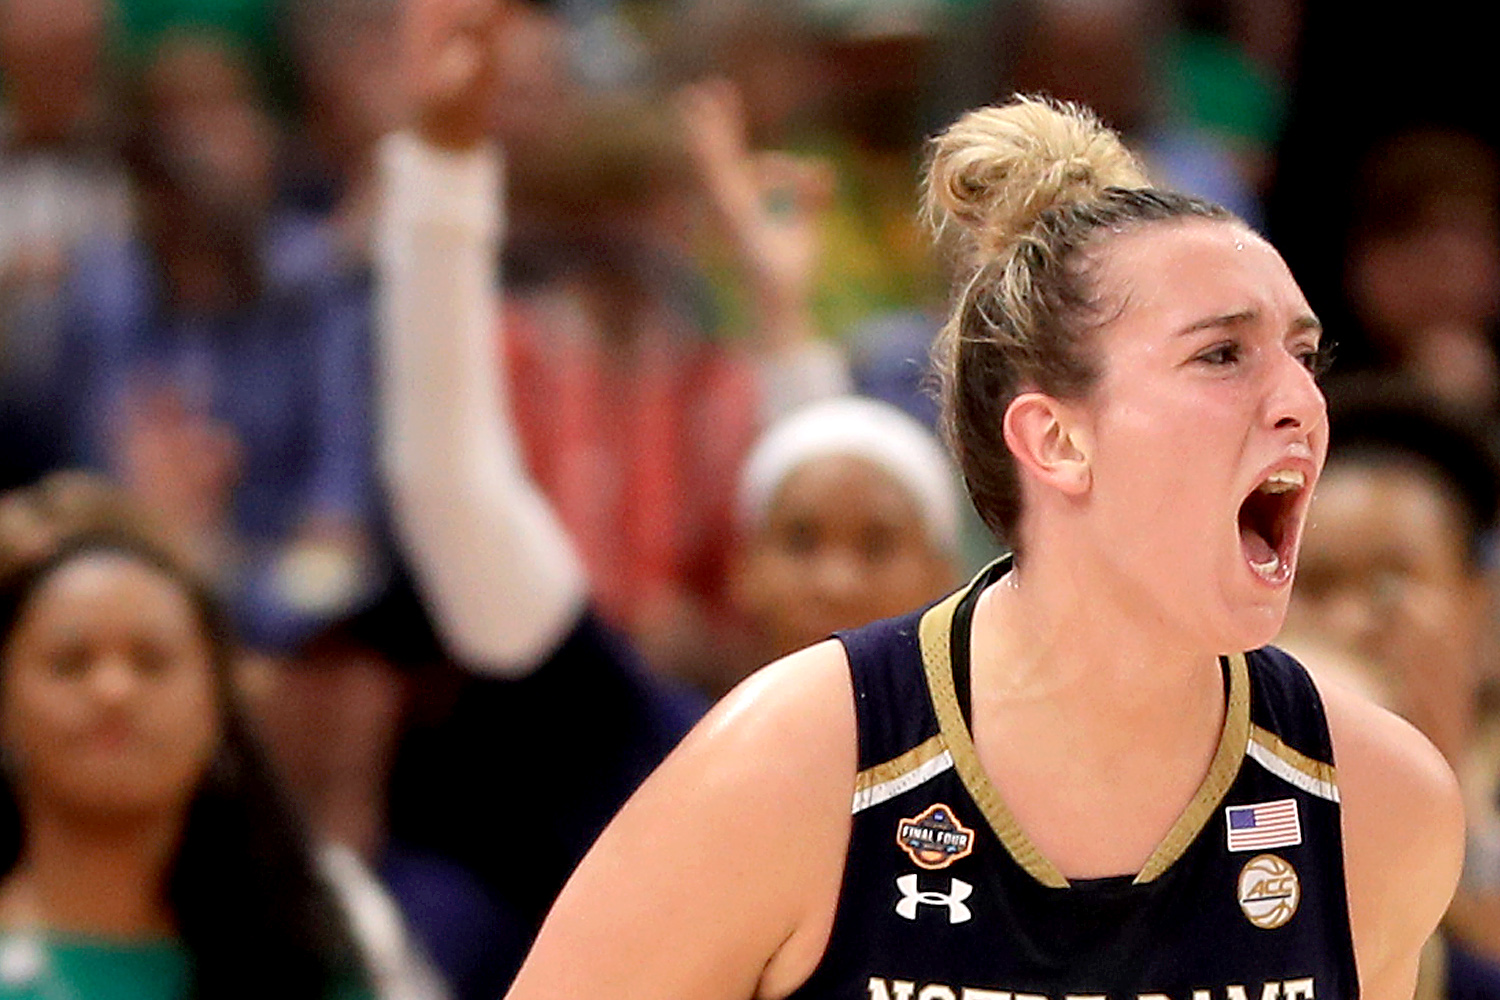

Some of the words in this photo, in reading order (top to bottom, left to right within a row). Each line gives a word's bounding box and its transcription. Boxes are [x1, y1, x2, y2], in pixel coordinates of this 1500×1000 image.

[902, 825, 934, 844] FINAL
[936, 831, 968, 848] FOUR
[1247, 876, 1295, 897] ACC
